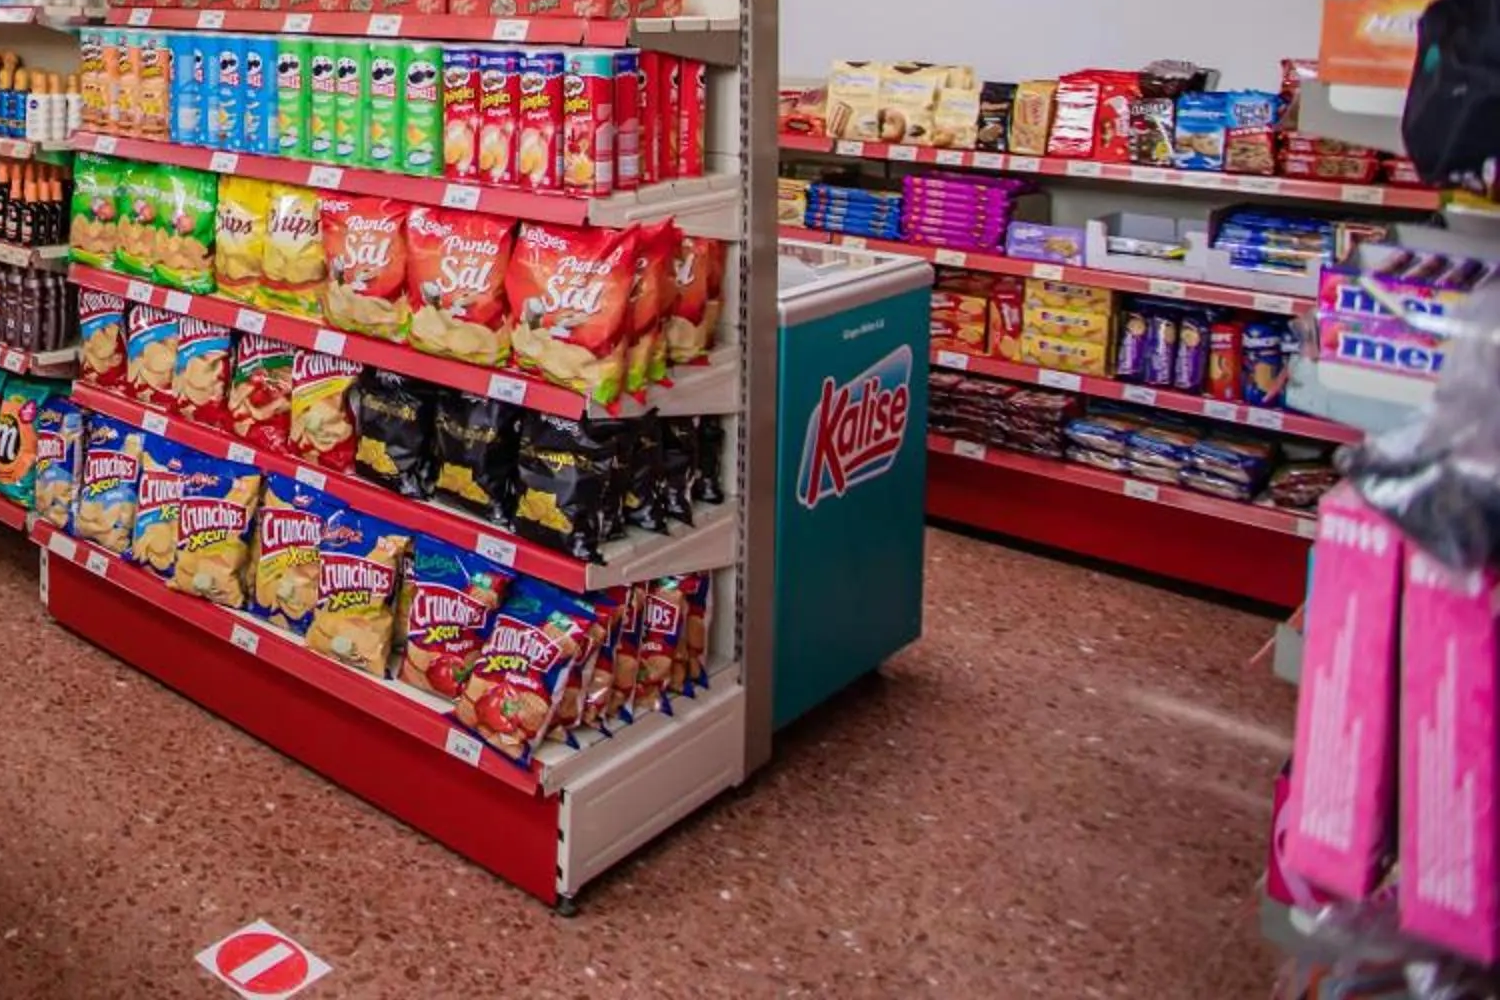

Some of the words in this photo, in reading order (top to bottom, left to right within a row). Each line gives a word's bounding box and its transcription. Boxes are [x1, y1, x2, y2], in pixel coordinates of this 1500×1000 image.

[344, 234, 391, 268] Sal
[444, 235, 498, 256] Punto
[436, 256, 494, 293] Sal
[807, 378, 909, 508] Kalise
[181, 501, 245, 532] Crunchips
[319, 559, 390, 593] Crunchips
[414, 590, 483, 626] Crunchips
